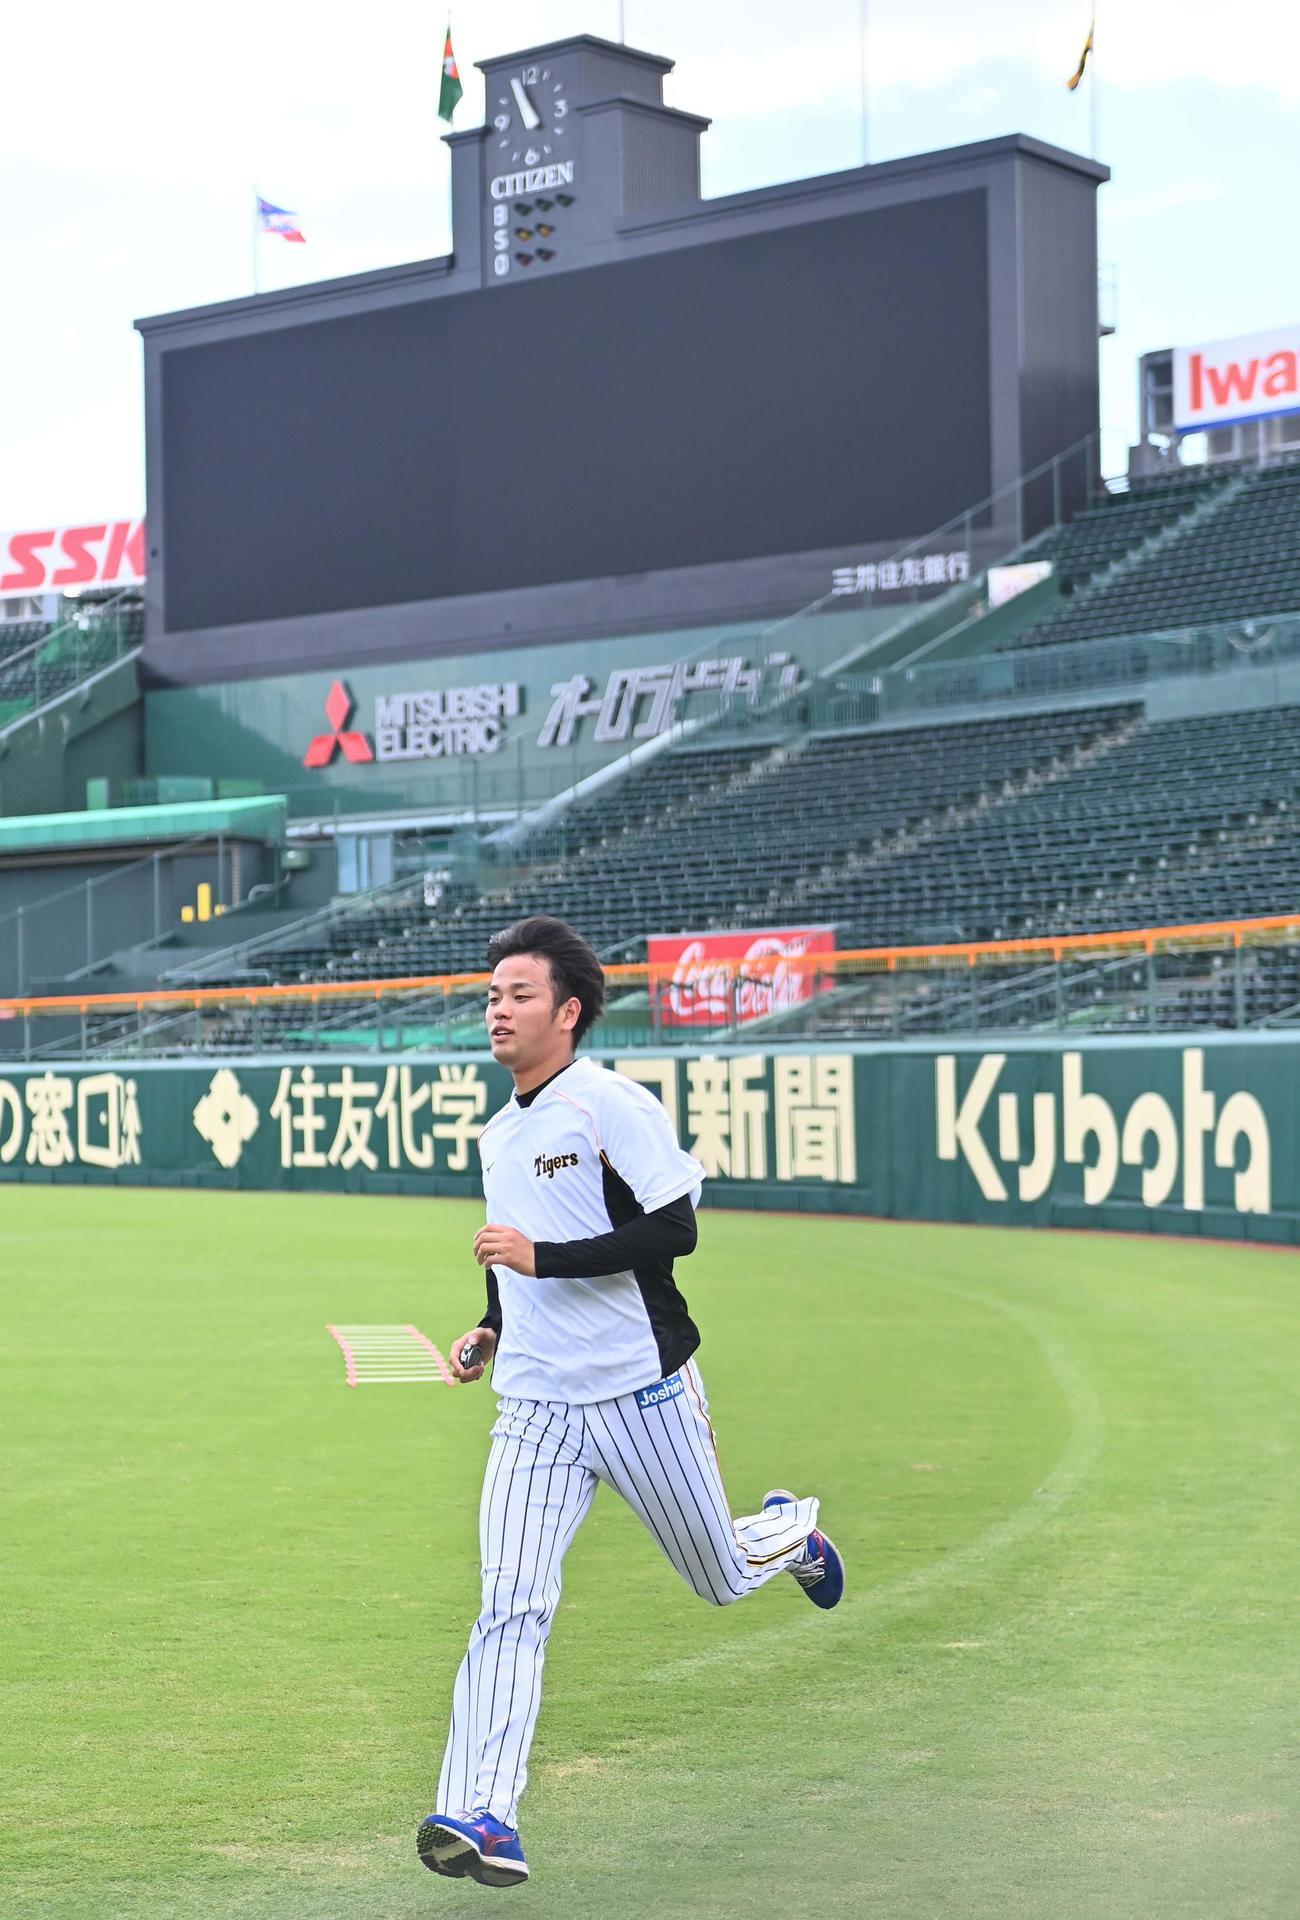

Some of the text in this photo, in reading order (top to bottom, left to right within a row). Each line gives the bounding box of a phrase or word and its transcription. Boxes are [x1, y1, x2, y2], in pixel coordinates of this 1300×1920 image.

[493, 113, 510, 131] 9
[554, 99, 568, 118] 3
[524, 147, 541, 165] 6
[491, 160, 574, 199] CITIZEN
[493, 204, 509, 227] B
[493, 229, 509, 251] S
[0, 519, 145, 590] SSK
[375, 681, 519, 727] MITSUBISHI
[375, 719, 500, 763] ELECTRIC
[270, 1065, 488, 1172] 住友化学
[936, 1048, 1271, 1215] Kubota
[533, 1153, 579, 1179] Tigers
[640, 1379, 684, 1406] Joshin
